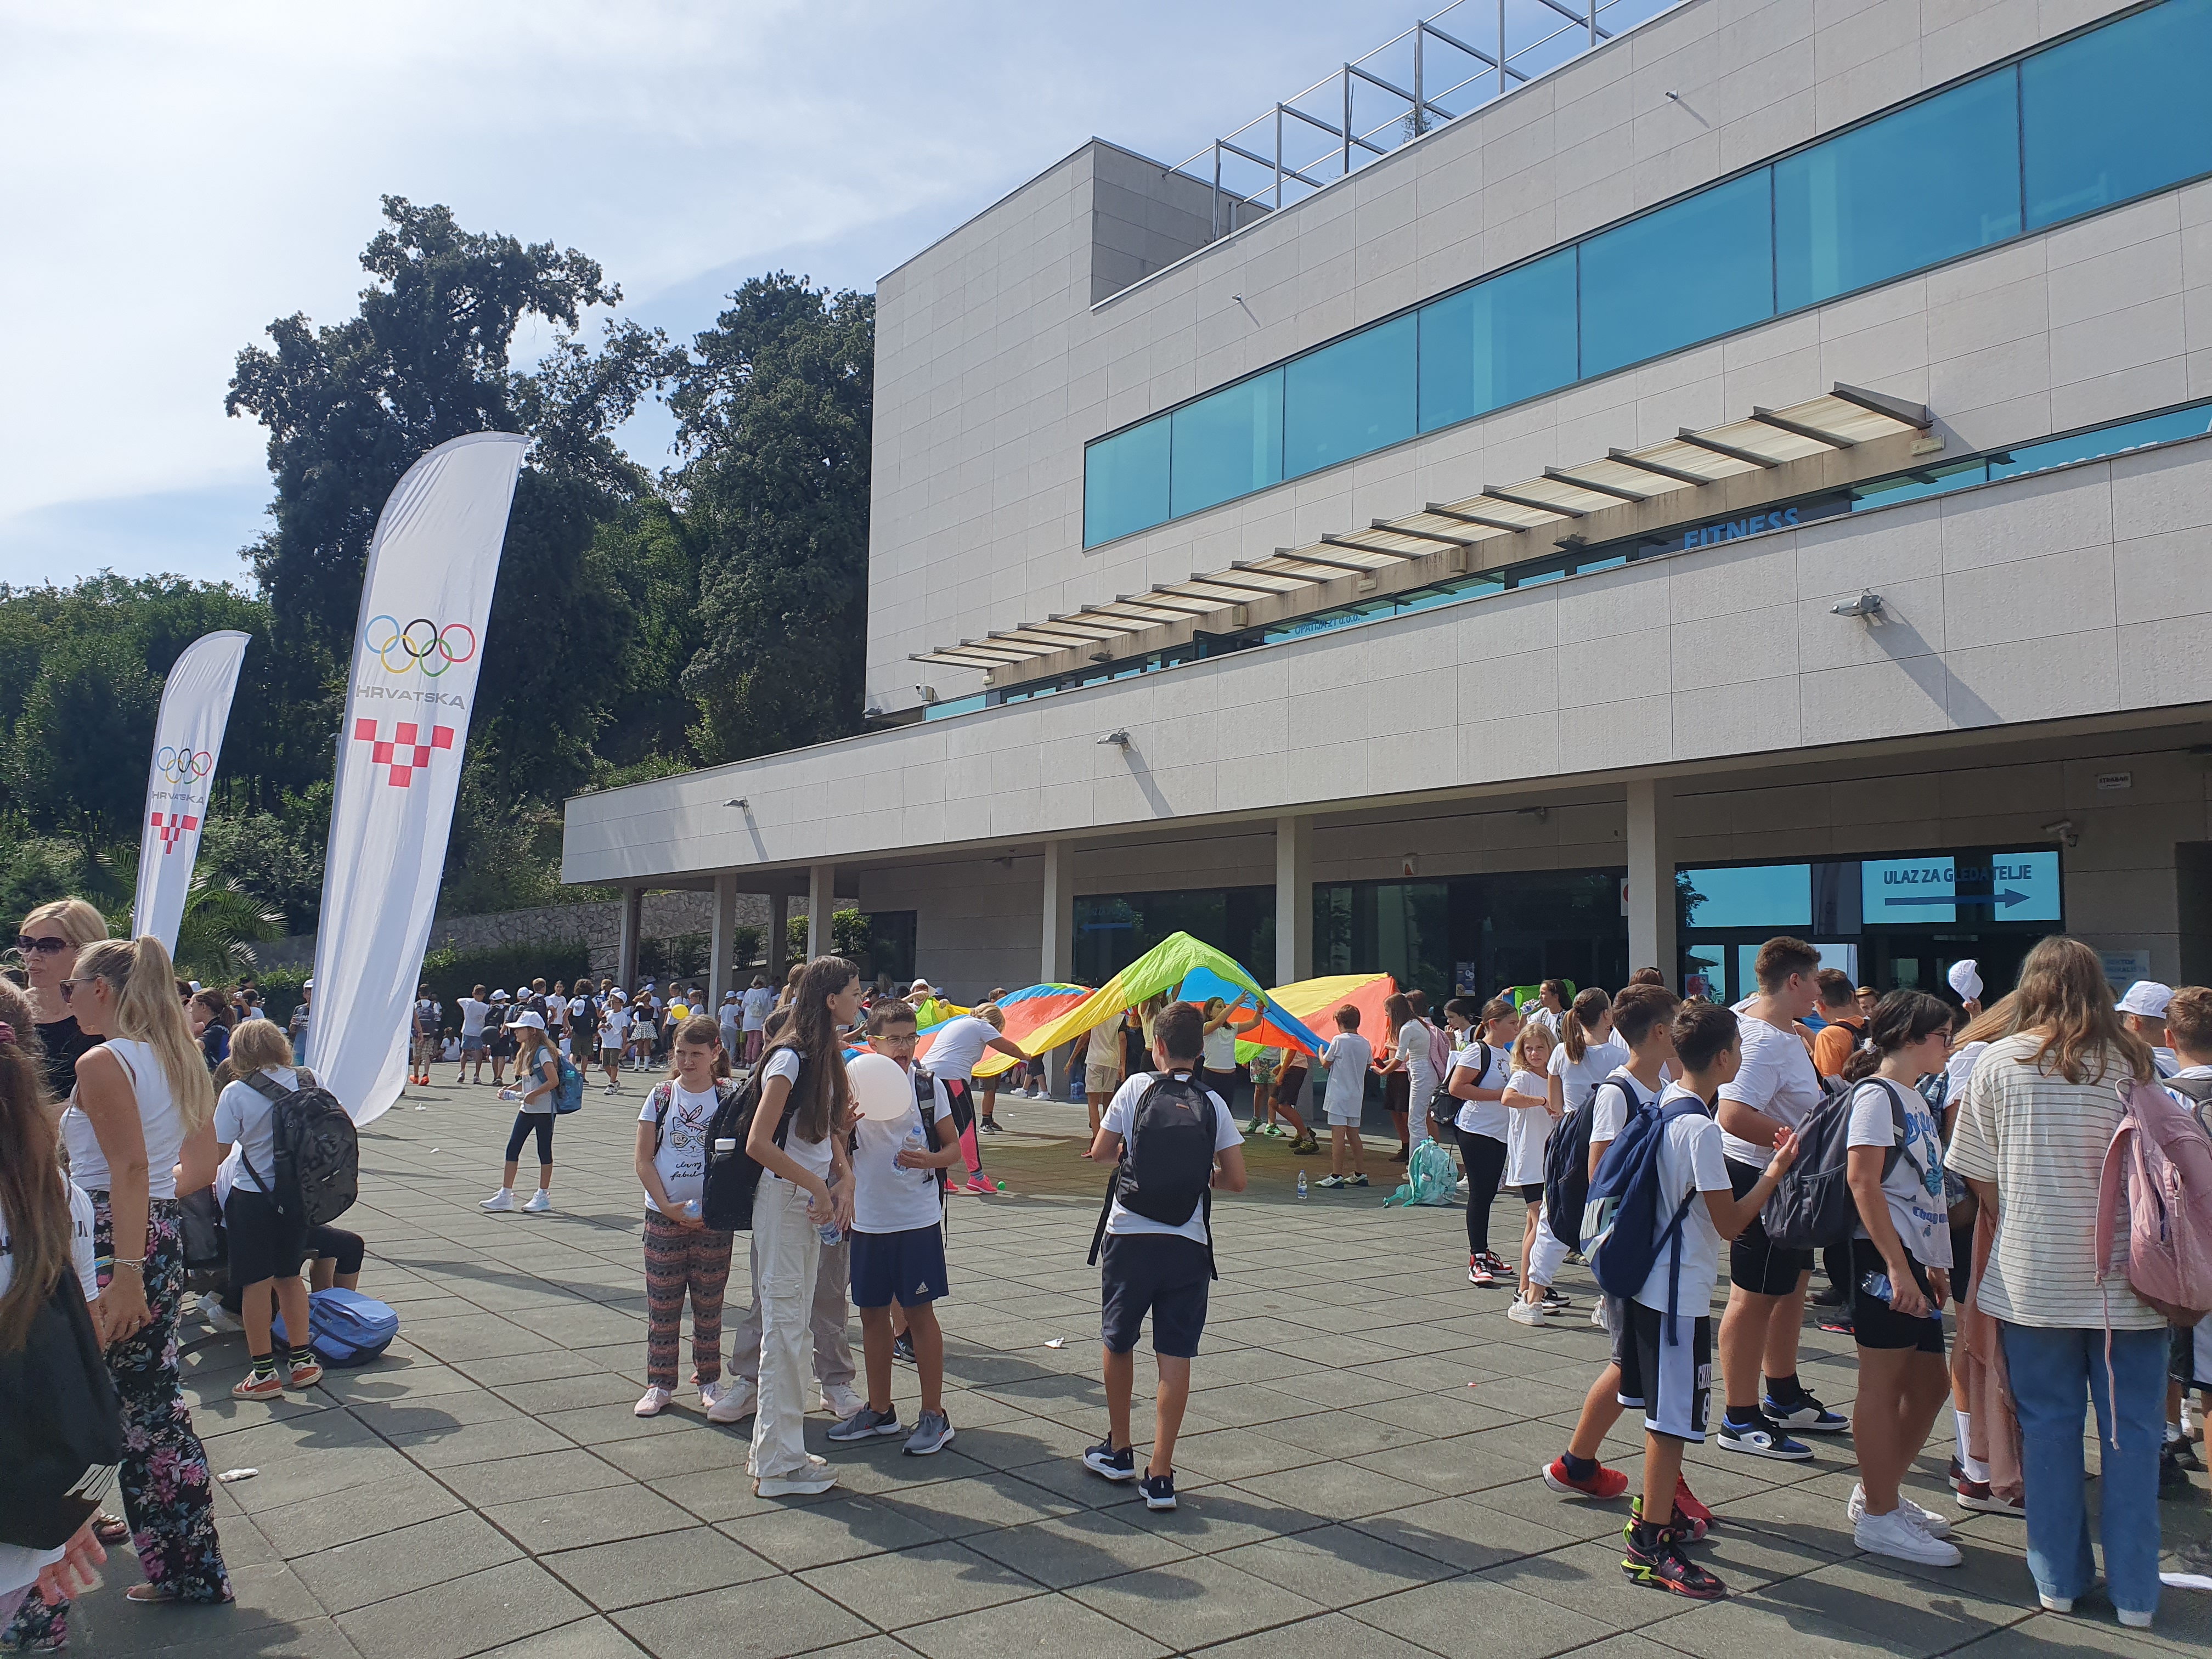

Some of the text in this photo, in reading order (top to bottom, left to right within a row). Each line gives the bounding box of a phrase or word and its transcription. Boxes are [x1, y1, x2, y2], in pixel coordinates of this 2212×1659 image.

[1684, 507, 1799, 550] FITNESS
[356, 684, 465, 710] HRVATSKA
[1883, 865, 2032, 884] ULAZ ZA GLEDATELJE
[670, 1171, 705, 1181] fabul
